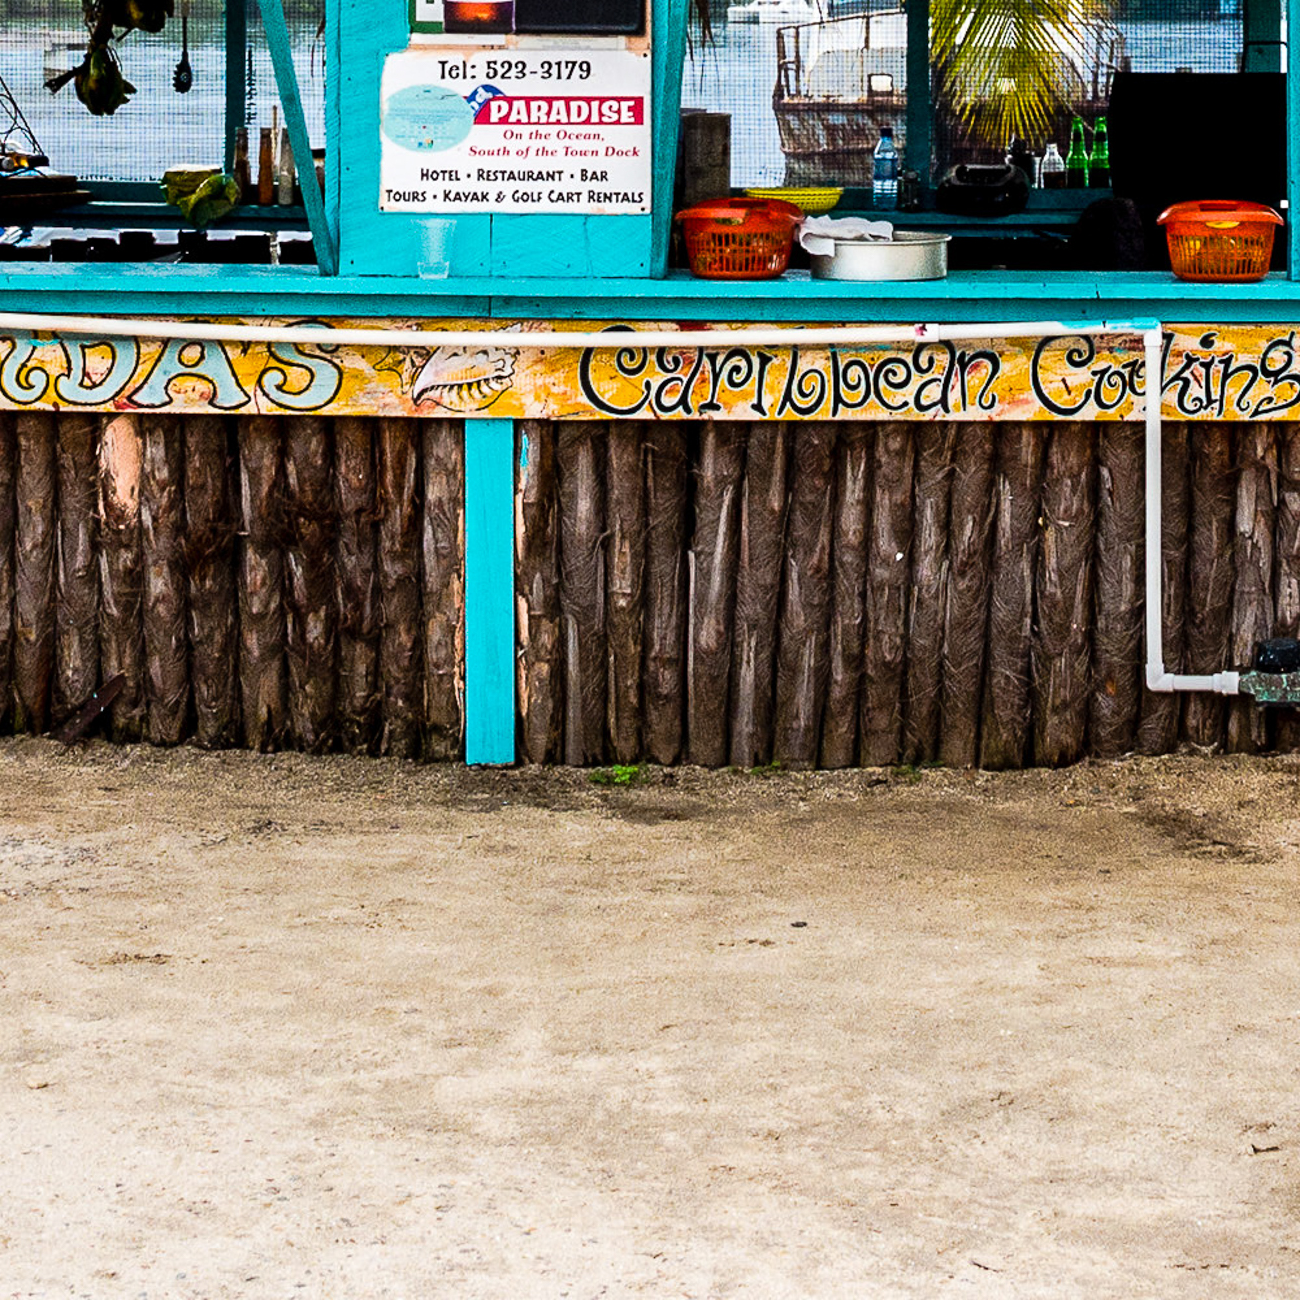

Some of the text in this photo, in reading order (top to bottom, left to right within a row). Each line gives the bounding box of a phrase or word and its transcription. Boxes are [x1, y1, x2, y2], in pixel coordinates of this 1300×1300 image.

[438, 60, 591, 79] Tel: 523-3179
[489, 100, 635, 124] PARADISE
[503, 130, 605, 142] On the Ocean,
[468, 146, 641, 160] South of the Town Dock
[420, 168, 608, 181] HOTEL RESTAURANT BAR
[386, 189, 644, 203] TOURS KAYAK & GOLF CART RENTALS
[578, 325, 1000, 417] Caribbean
